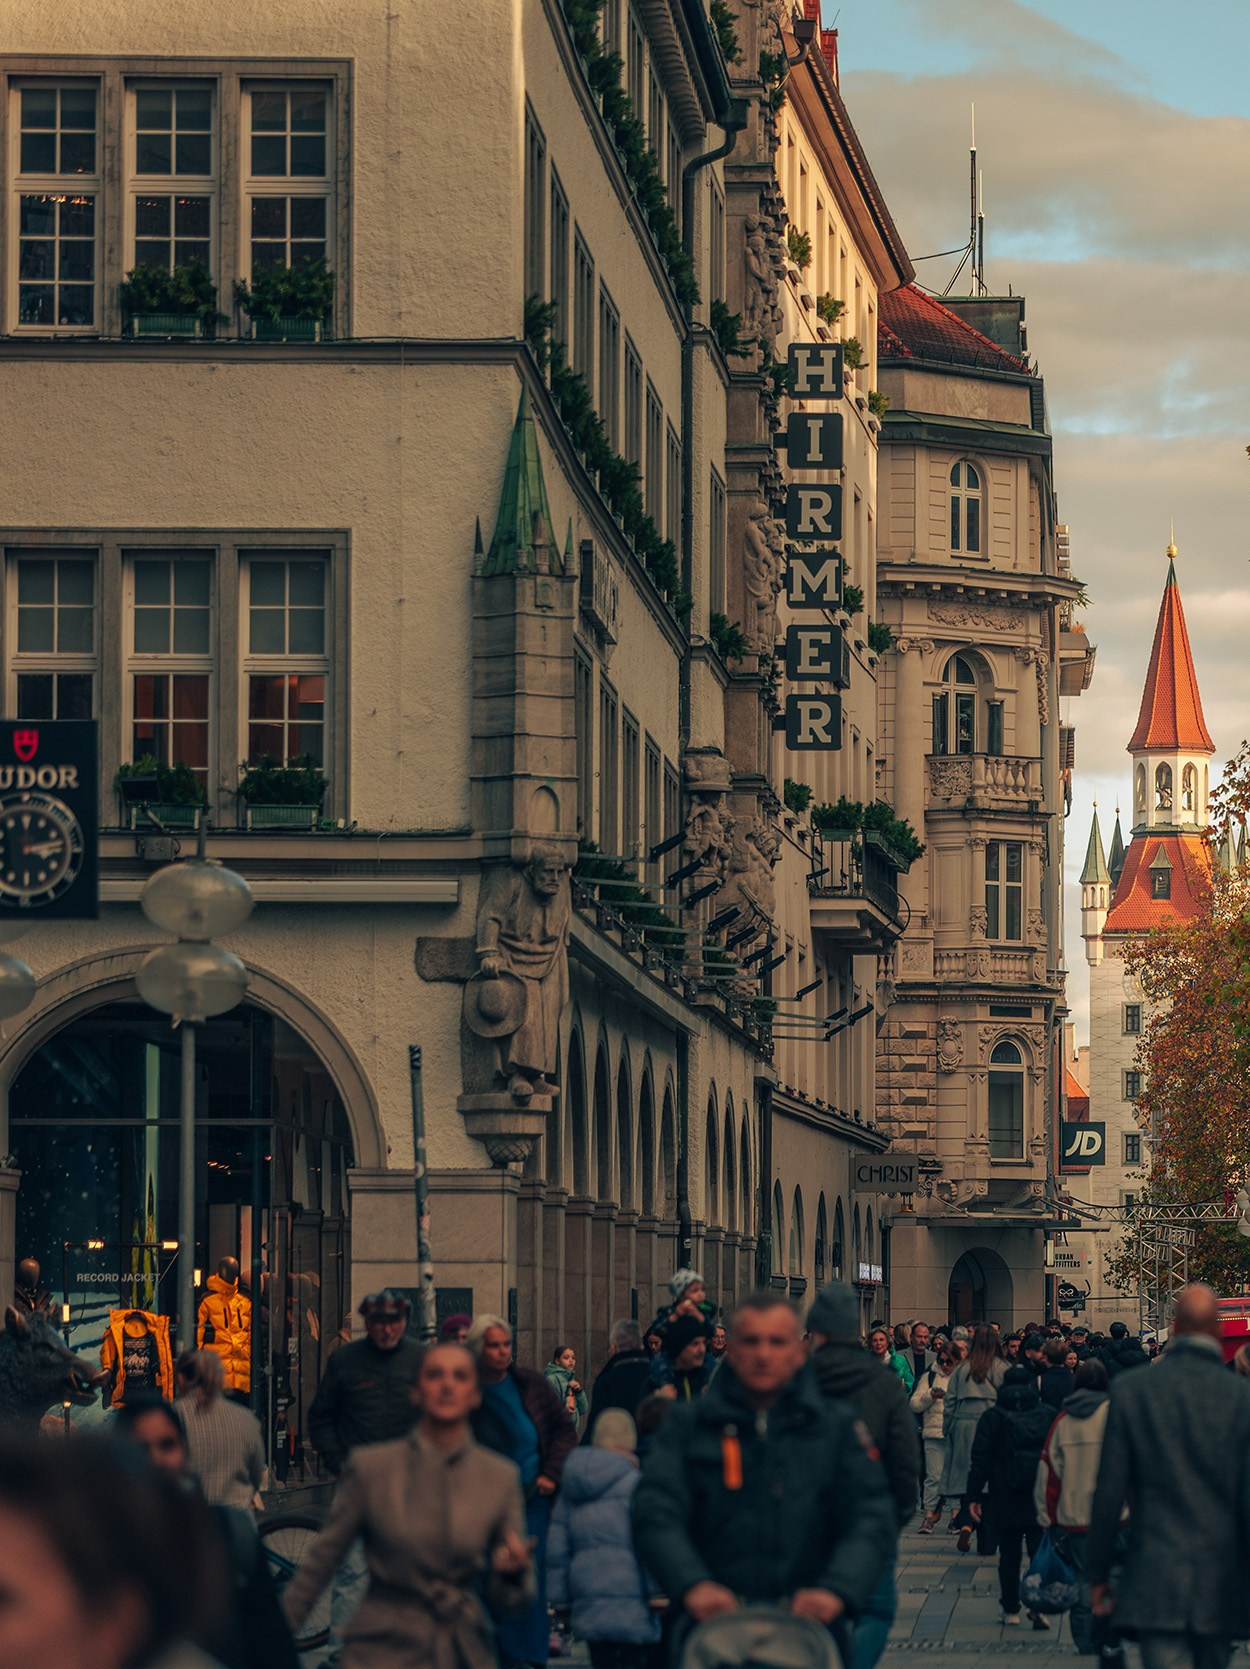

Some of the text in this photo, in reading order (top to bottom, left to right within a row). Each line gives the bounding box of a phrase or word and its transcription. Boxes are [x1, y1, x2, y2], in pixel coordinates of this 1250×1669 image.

[788, 349, 840, 744] HIRMER
[1065, 1130, 1102, 1157] JD
[857, 1165, 915, 1183] CHRIST
[76, 1273, 160, 1283] RECORD JACKET
